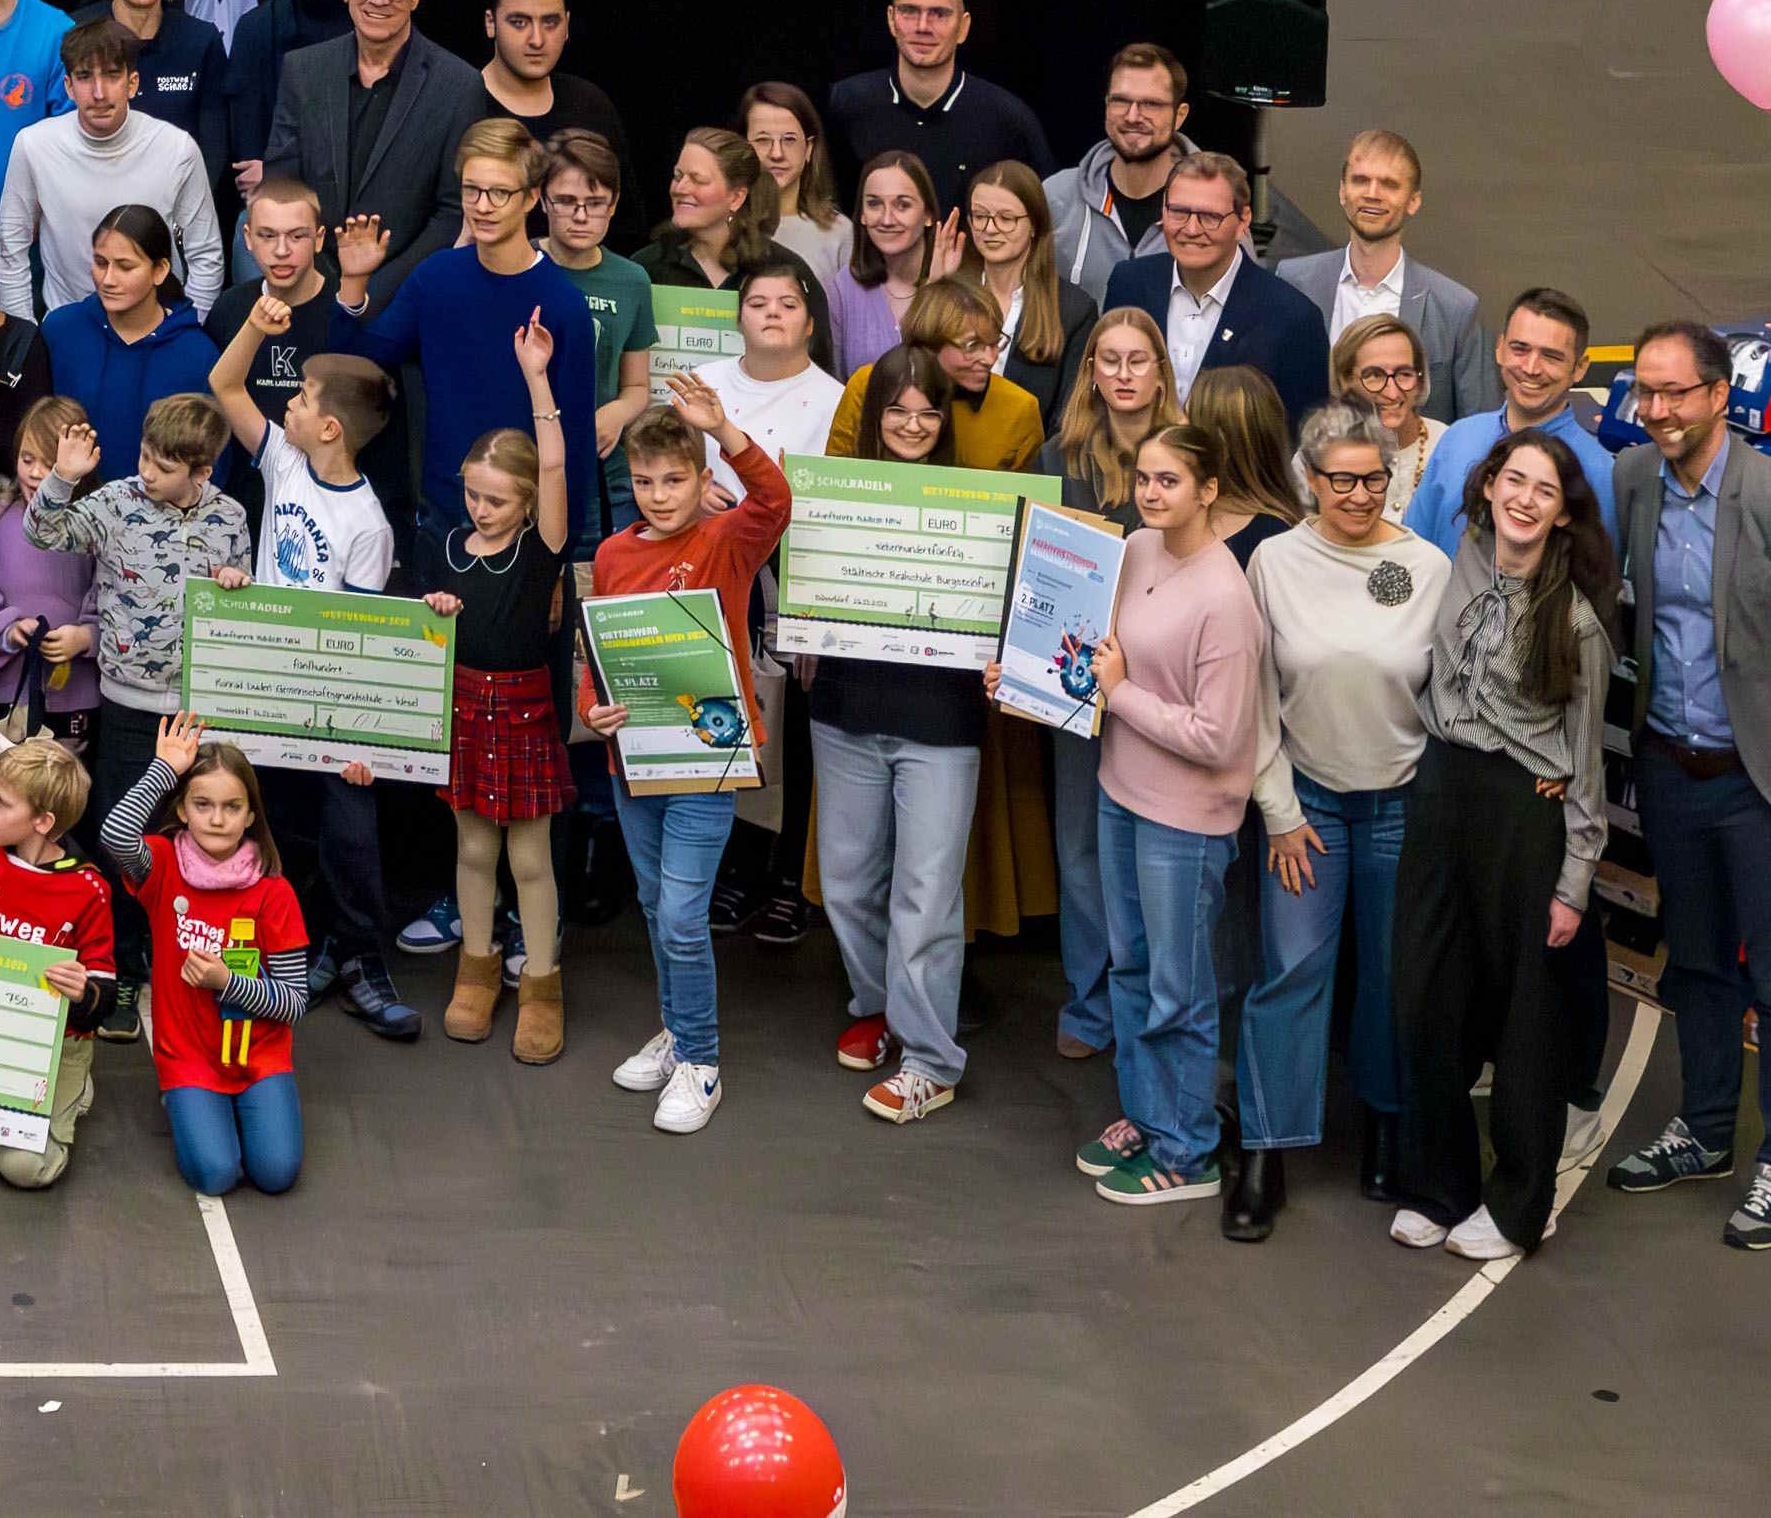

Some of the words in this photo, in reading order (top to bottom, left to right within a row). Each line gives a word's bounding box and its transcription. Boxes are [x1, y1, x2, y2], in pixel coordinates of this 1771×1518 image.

[686, 337, 714, 348] EURO
[817, 475, 892, 493] SCHULRADELN
[927, 517, 957, 531] EURO
[218, 598, 292, 615] SCHULRADELN
[1020, 593, 1027, 604] 2.
[1029, 595, 1055, 615] PLATZ
[326, 638, 354, 650] EURO
